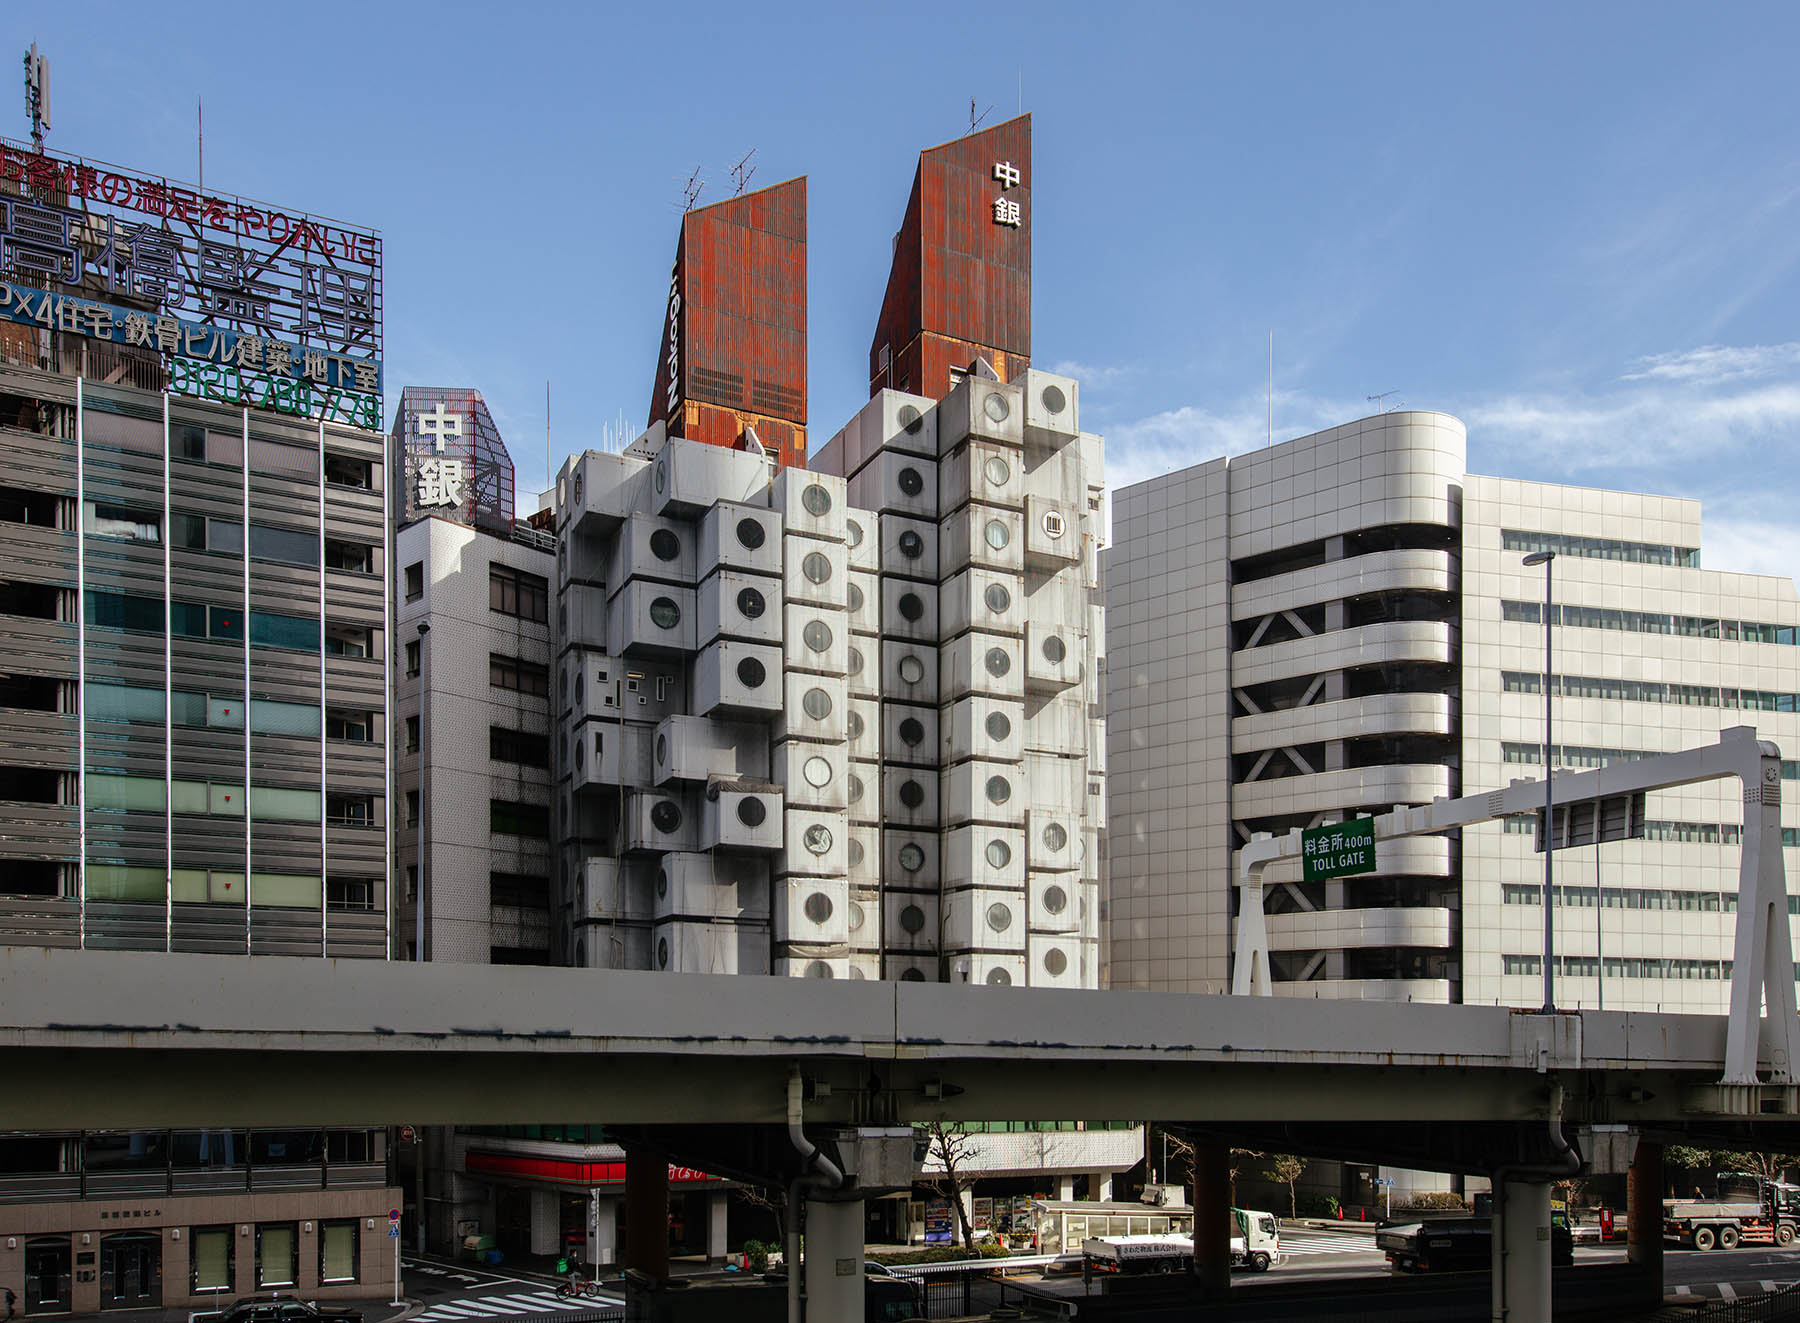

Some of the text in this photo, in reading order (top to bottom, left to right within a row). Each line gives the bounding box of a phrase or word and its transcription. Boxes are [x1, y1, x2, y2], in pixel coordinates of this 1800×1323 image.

[994, 161, 1021, 227] 中銀
[171, 357, 380, 430] 0120-789-778
[418, 402, 463, 507] 中銀
[1312, 851, 1365, 872] TOLL GATE
